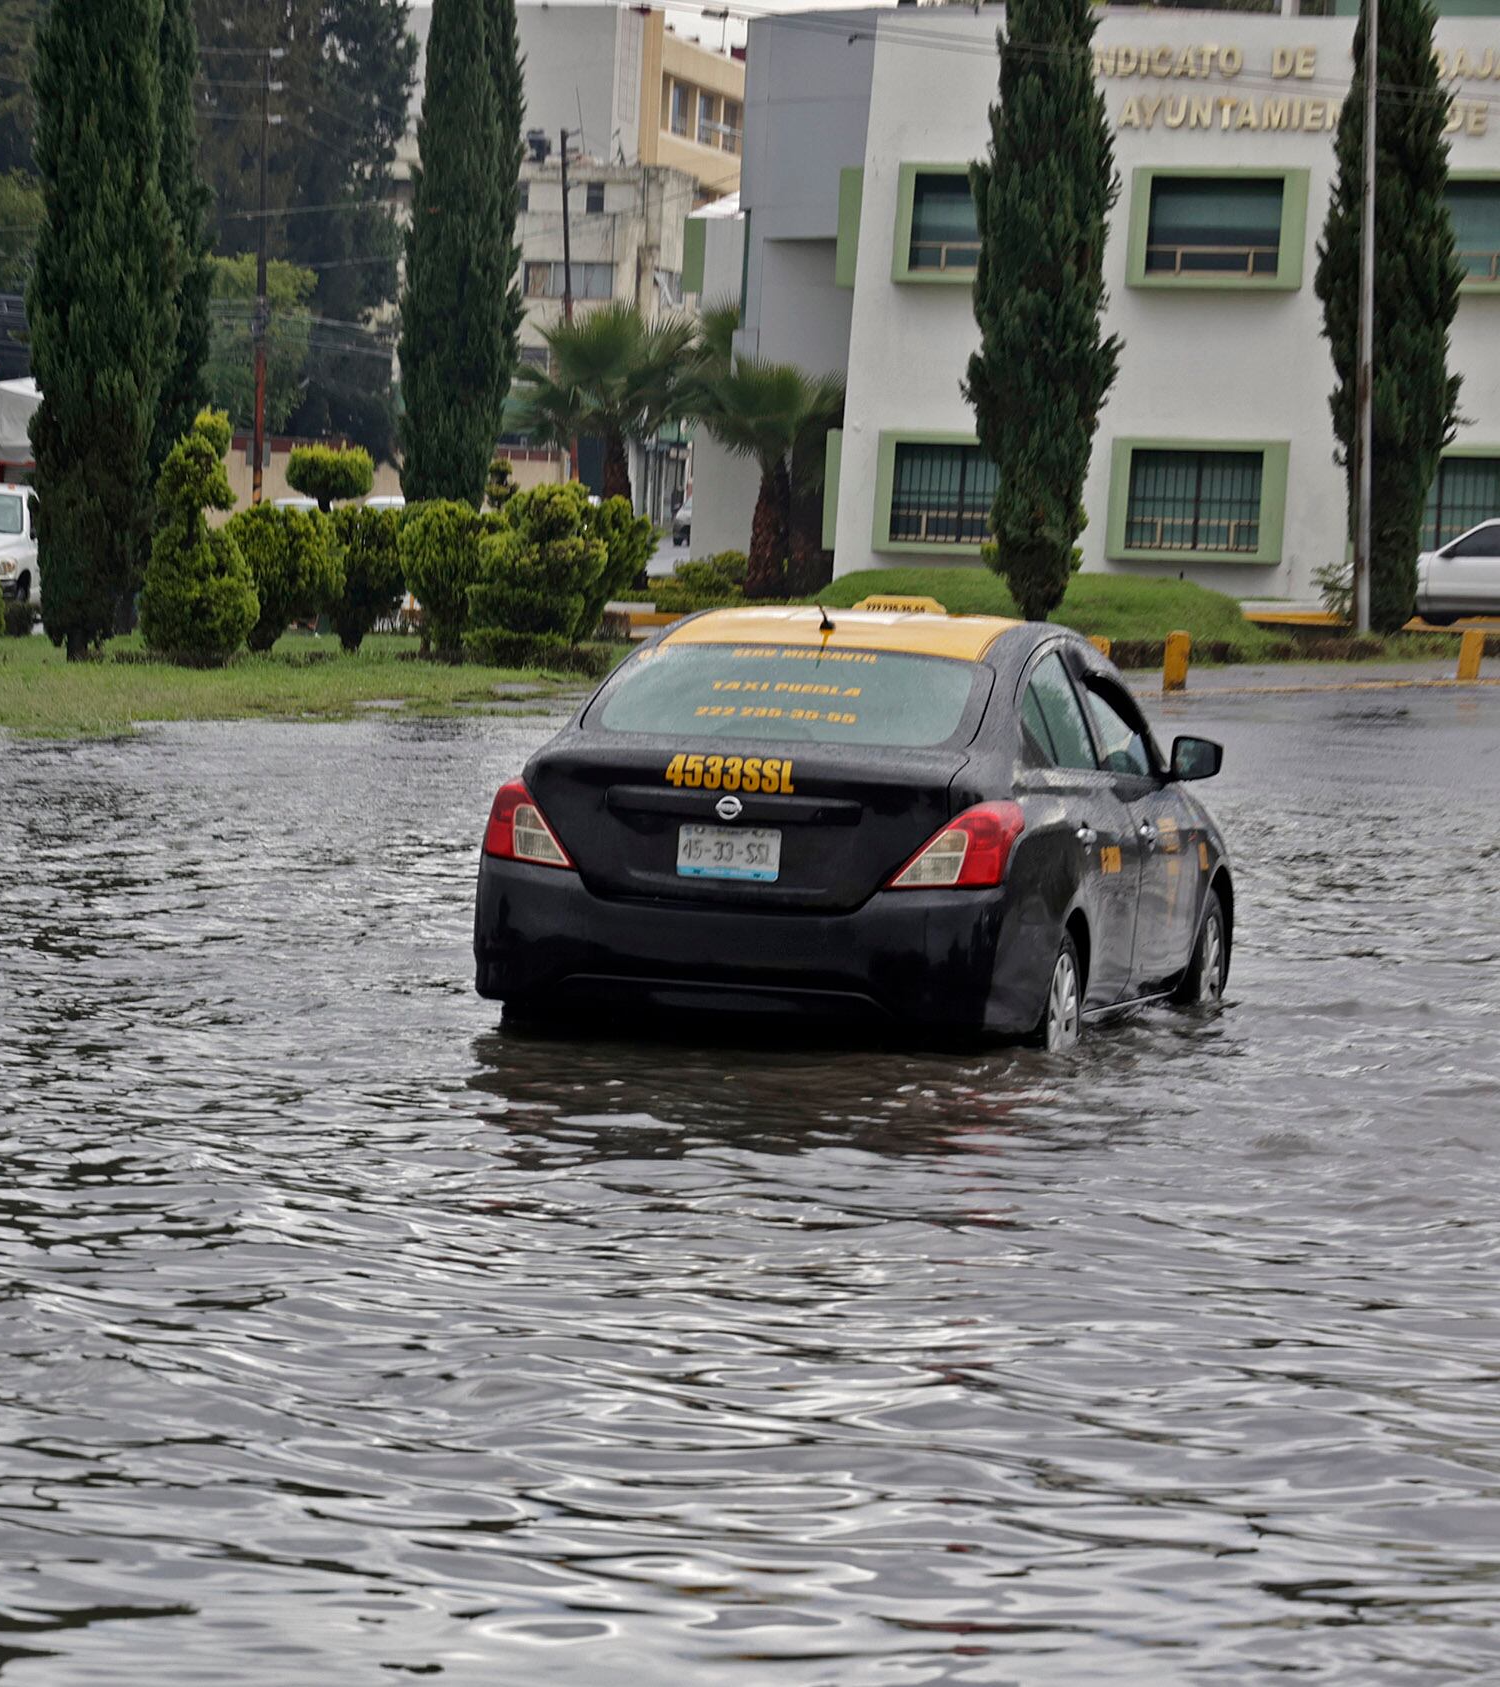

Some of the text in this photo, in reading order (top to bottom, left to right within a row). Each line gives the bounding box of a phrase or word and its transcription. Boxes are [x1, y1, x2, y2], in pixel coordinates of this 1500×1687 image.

[1092, 42, 1243, 79] NDICATO
[1272, 44, 1316, 79] DE
[1117, 94, 1489, 137] AYUNTAMIEN DE
[781, 650, 878, 664] MERCANTIL
[712, 680, 862, 697] TAXI PUEBLA
[694, 706, 736, 717] 222
[665, 752, 795, 794] 4533SSL
